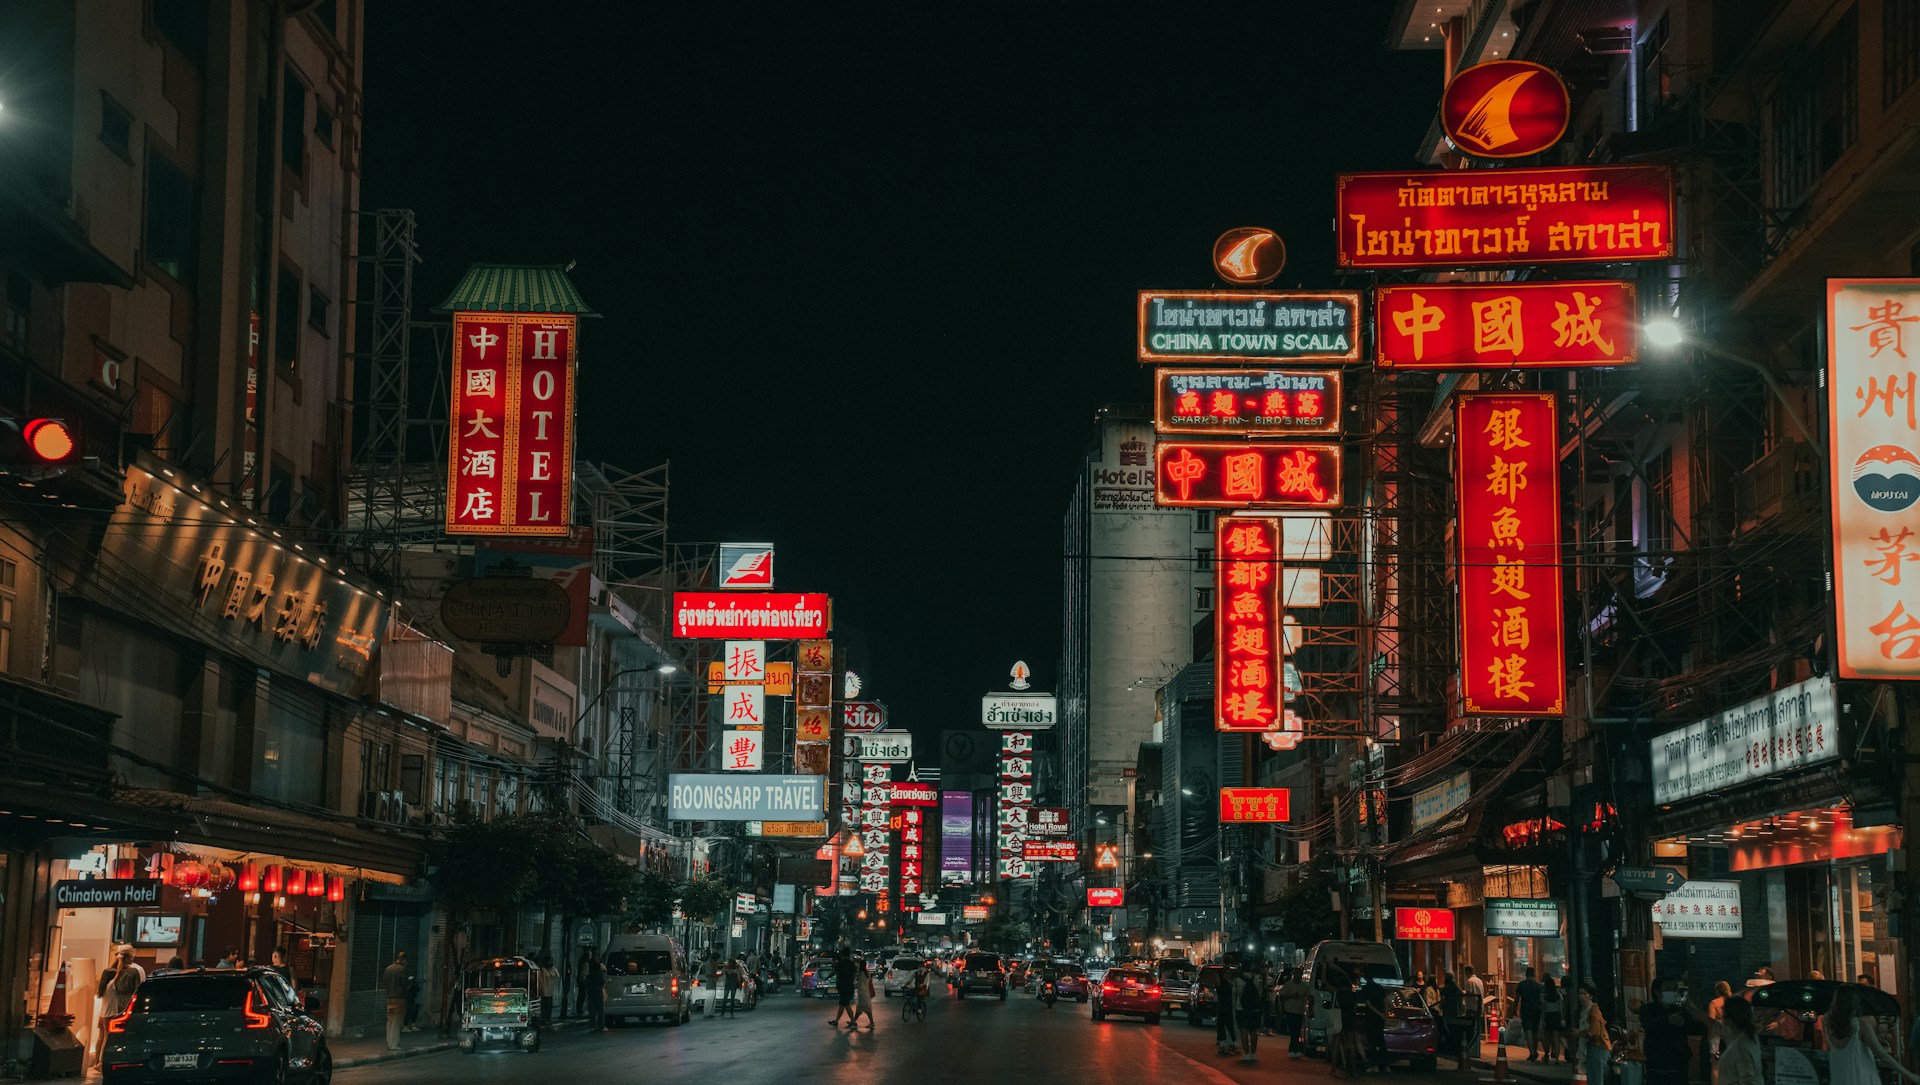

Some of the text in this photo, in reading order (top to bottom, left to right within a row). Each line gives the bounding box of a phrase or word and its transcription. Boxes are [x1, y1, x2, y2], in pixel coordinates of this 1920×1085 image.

[1348, 209, 1664, 257] ไชน่าทาวน์ สกาล่า
[1153, 298, 1346, 327] ไชน่าทาวน์ สกาล่า
[1391, 291, 1616, 361] 中國城
[1152, 333, 1348, 351] CHINA TOWN SCALA
[1848, 299, 1920, 431] 貴州
[459, 326, 500, 521] 中國大酒店
[528, 330, 559, 522] HOTEL
[1171, 416, 1219, 425] SHARK'S
[1255, 416, 1292, 425] BIRD'S
[1295, 416, 1324, 425] NEST
[1093, 469, 1142, 485] Hotel
[1166, 448, 1324, 502] 中國城
[1870, 489, 1909, 501] MOUTAI
[1482, 407, 1536, 703] 銀都魚翅酒樓
[678, 595, 822, 636] รุ่งทรัพย์การท่องเที่ยว
[1863, 526, 1920, 661] 茅台
[1225, 525, 1273, 724] 銀都魚翅酒樓
[727, 646, 763, 769] 振成豐
[673, 784, 819, 810] ROONGSARP TRAVEL
[1007, 735, 1025, 875] 和成興大金行
[867, 768, 886, 890] 和成興大金行
[1048, 823, 1068, 831] Royal
[904, 811, 919, 910] 聯成興大金
[1666, 872, 1675, 885] 2
[57, 884, 156, 903] Chinatown Hotel
[1422, 926, 1448, 934] Hostel
[1661, 921, 1741, 931] SCALA SHARK-FINS RESTAURANT
